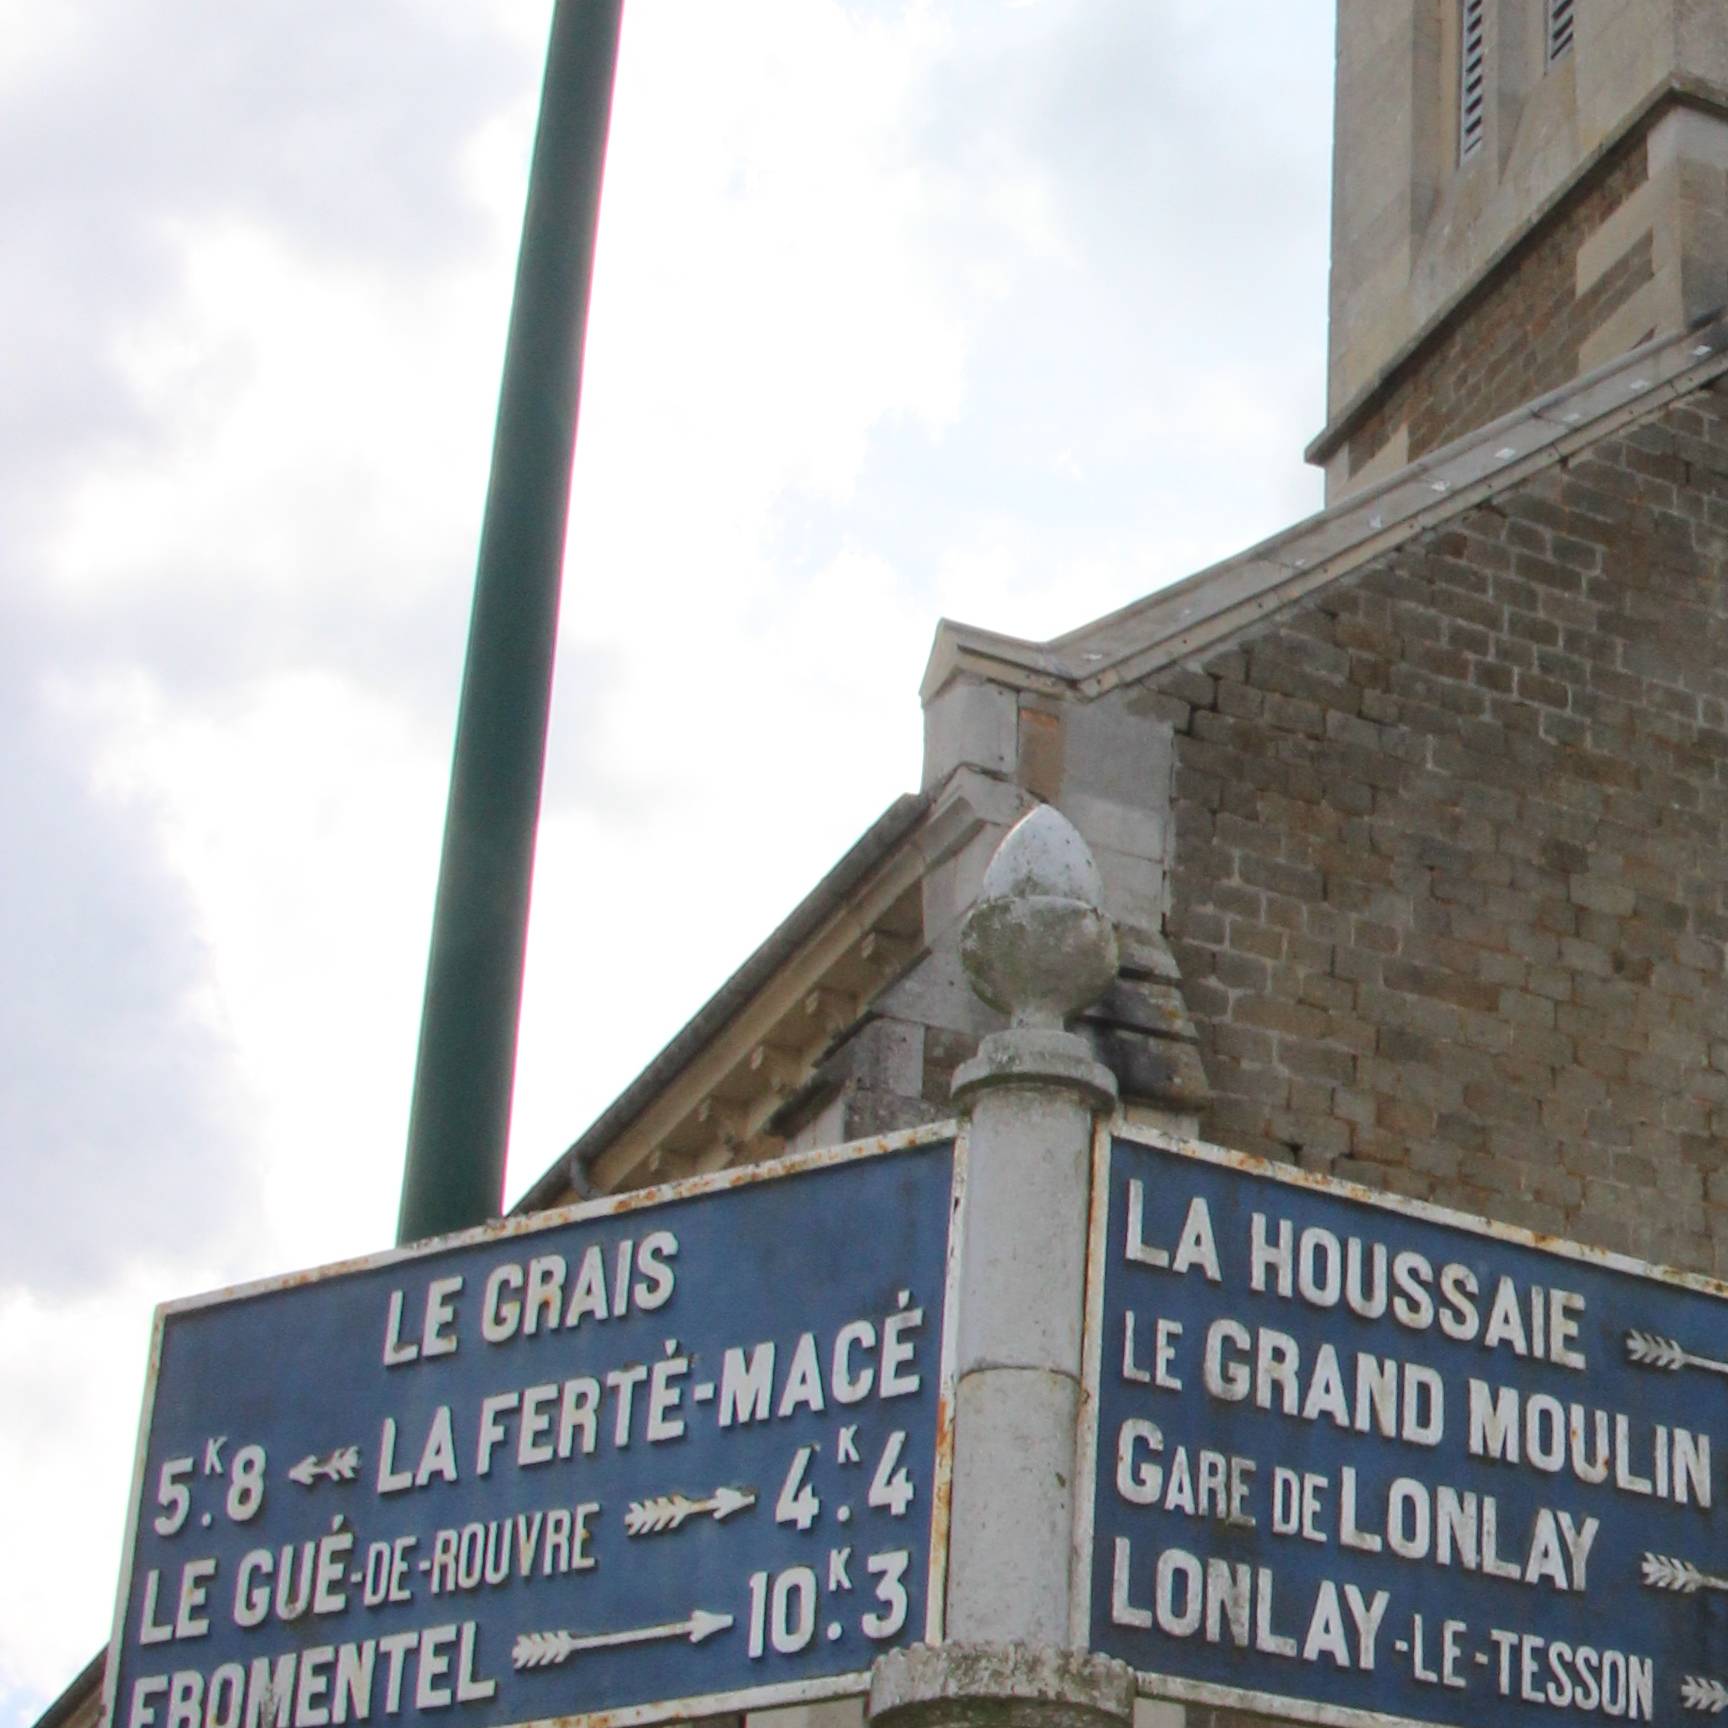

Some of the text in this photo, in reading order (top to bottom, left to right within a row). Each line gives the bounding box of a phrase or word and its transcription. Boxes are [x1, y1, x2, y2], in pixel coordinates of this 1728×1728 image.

[383, 1231, 680, 1367] LE GRAIS
[1124, 1179, 1221, 1281] LA
[1249, 1211, 1587, 1370] HOUSSAIE
[375, 1406, 458, 1494] LA
[476, 1289, 925, 1477] FERTÉ-MACÉ
[1121, 1310, 1184, 1392] LE
[1202, 1318, 1445, 1447] GRAND
[1468, 1378, 1712, 1510] MOULIN
[139, 1560, 217, 1646] LE
[232, 1501, 601, 1631] GUÉ-DE-ROUVRE
[1114, 1418, 1257, 1528] GARE
[1271, 1463, 1329, 1545] DE
[1338, 1467, 1600, 1592] LONLAY
[1110, 1536, 1655, 1722] LONLAY-LE-TESSON
